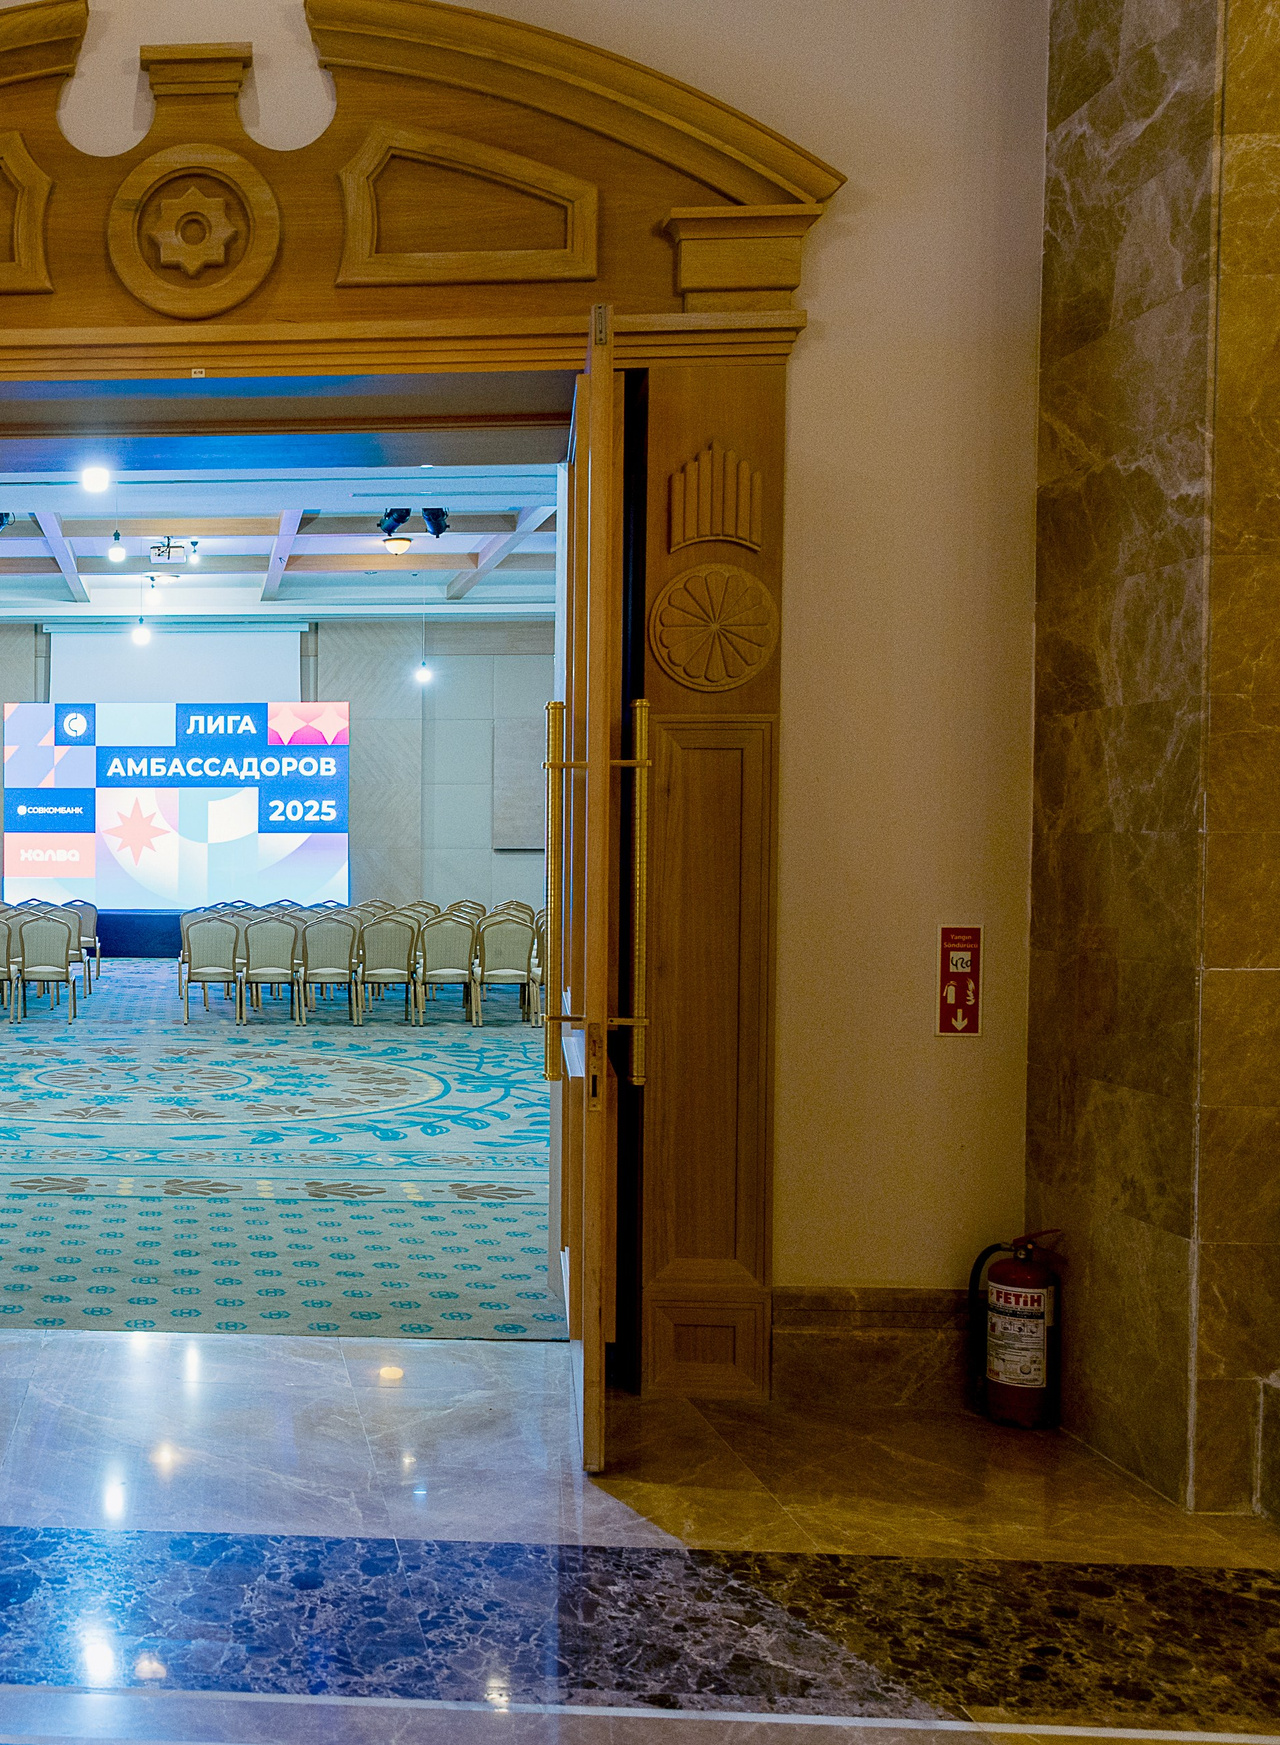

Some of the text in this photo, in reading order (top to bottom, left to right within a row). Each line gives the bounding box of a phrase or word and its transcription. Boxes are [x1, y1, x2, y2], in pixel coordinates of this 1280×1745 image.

[186, 715, 257, 735] ЛИГА
[106, 757, 337, 780] АМБАССАДОРОВ
[27, 806, 84, 814] СОВКОМБАНК
[268, 800, 337, 822] 2025
